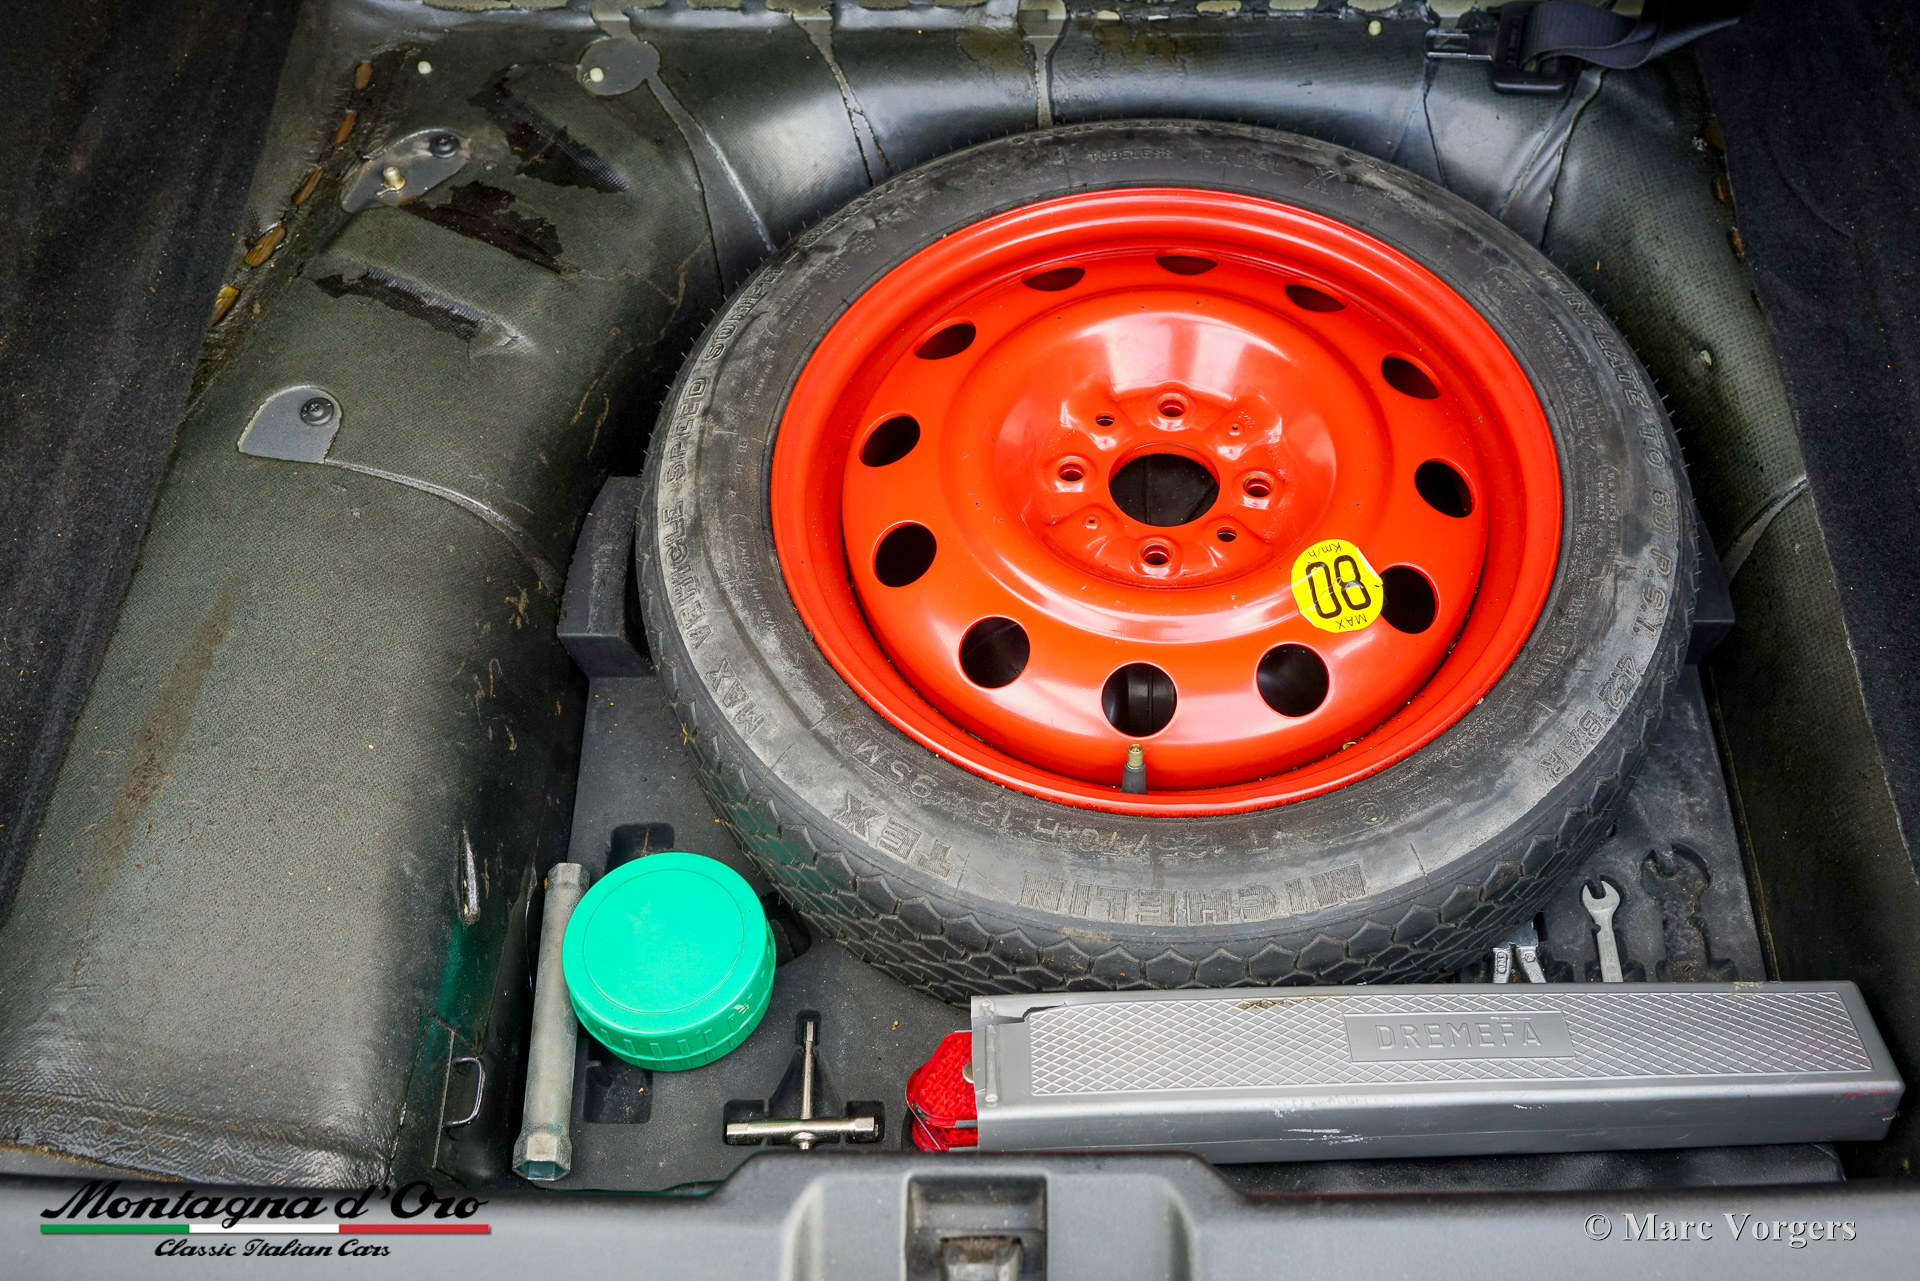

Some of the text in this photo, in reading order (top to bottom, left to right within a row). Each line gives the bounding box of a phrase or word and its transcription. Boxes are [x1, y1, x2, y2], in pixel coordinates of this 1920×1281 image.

[1558, 287, 1650, 409] INFLATE
[665, 376, 708, 485] SPEED
[1638, 426, 1667, 469] TO
[1650, 487, 1672, 535] 60
[661, 500, 712, 649] VEHICLE
[1305, 554, 1371, 620] 80
[1335, 613, 1368, 630] MAX
[703, 656, 770, 739] MAX
[1539, 709, 1607, 781] BAR
[832, 790, 1367, 926] MICHELIN TEX
[1374, 1020, 1541, 1050] DREMEFA
